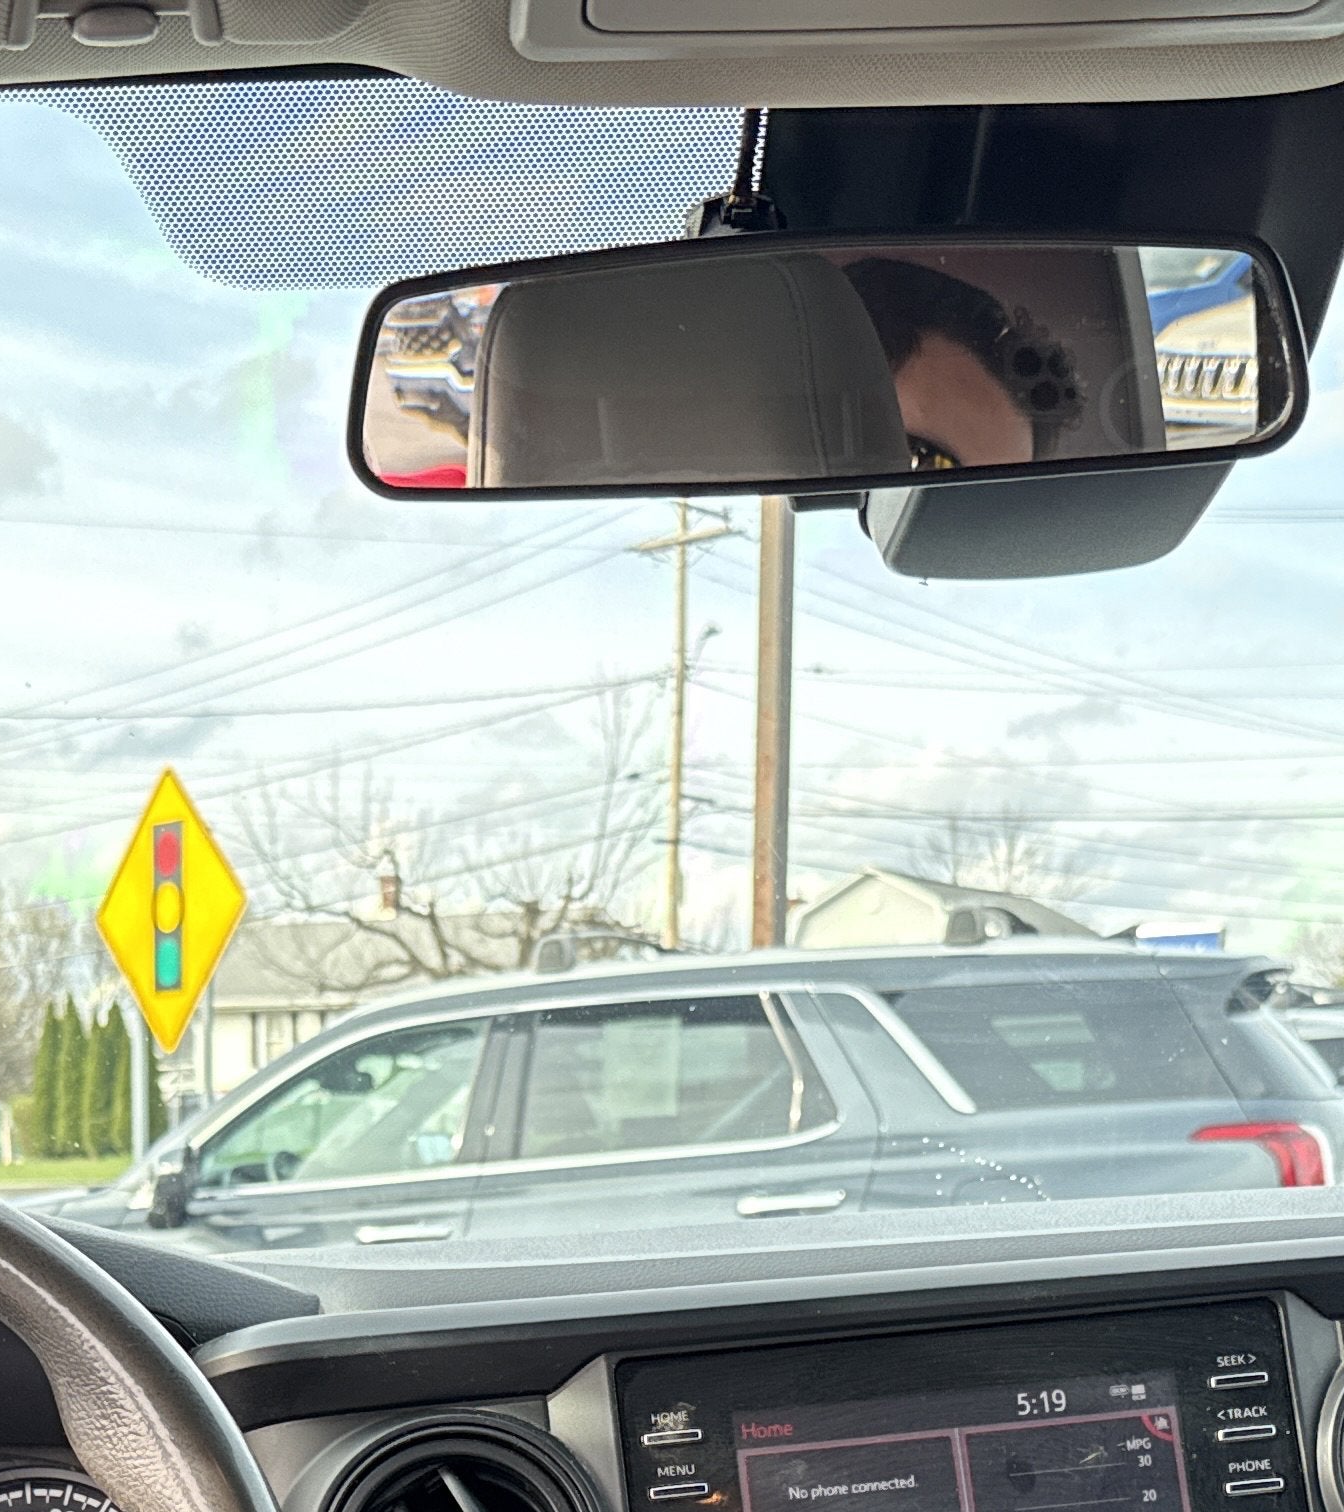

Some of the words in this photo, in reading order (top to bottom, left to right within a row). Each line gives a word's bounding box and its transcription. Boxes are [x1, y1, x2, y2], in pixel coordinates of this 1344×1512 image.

[1217, 1354, 1246, 1367] SEEK
[1017, 1388, 1067, 1416] 5:19
[650, 1409, 690, 1425] HOME
[741, 1422, 794, 1440] Home
[1126, 1437, 1152, 1451] MPG
[1137, 1455, 1152, 1468] 30
[1228, 1458, 1272, 1474] PHONE
[657, 1463, 696, 1478] MENU
[788, 1486, 808, 1501] No
[811, 1483, 848, 1500] phone
[851, 1474, 919, 1495] connected.
[1142, 1489, 1157, 1503] 20
